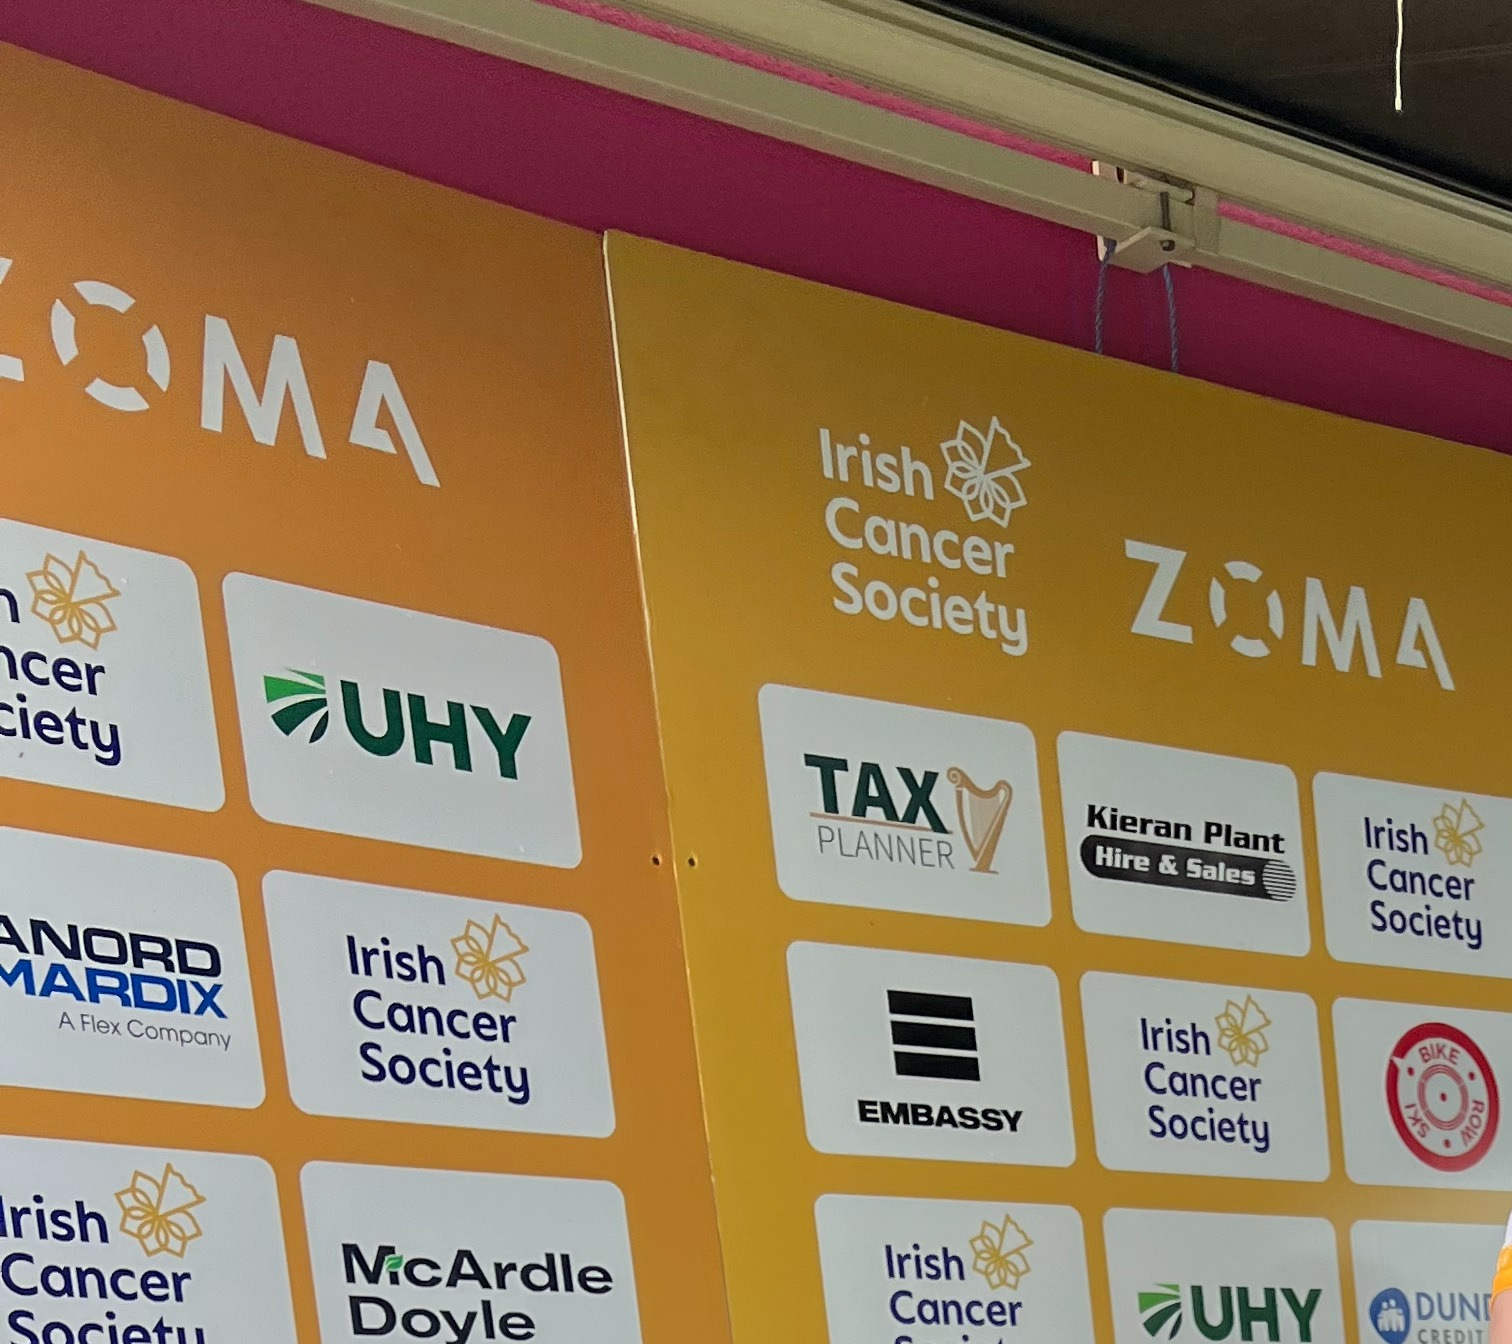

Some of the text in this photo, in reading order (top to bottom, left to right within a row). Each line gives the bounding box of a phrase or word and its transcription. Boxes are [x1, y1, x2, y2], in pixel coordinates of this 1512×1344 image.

[0, 258, 440, 487] OMA
[817, 426, 934, 500] Irish
[825, 497, 1014, 578] Cancer
[831, 561, 1028, 656] Society
[1124, 539, 1456, 691] ZOMA
[0, 645, 105, 696] ncer
[0, 693, 122, 766] ciety
[340, 679, 532, 780] UHY
[804, 753, 949, 834] TAX
[817, 826, 955, 870] PLANNER
[1086, 804, 1286, 855] Kieran Plant
[1364, 816, 1429, 857] Irish
[1095, 846, 1255, 888] Hire & Sales
[1367, 857, 1475, 901] Cancer
[1371, 900, 1483, 950] Society
[346, 934, 446, 985] Irish
[59, 1012, 231, 1051] A Flex Company
[353, 989, 517, 1043] Cancer
[1140, 1017, 1212, 1056] Irish
[359, 1041, 531, 1105] Society
[1418, 1043, 1461, 1065] BIKE
[1144, 1062, 1262, 1102] Cancer
[857, 1099, 1023, 1133] EMBASSY
[1149, 1105, 1270, 1153] Society
[1404, 1103, 1431, 1139] SKI
[1459, 1100, 1485, 1147] ROW
[1, 1252, 192, 1302] Cancer
[342, 1243, 614, 1294] McArdle
[885, 1243, 965, 1281] Irish
[890, 1290, 1023, 1327] Cancer
[1190, 1285, 1323, 1343] UHY
[1417, 1329, 1484, 1344] CREDIT
